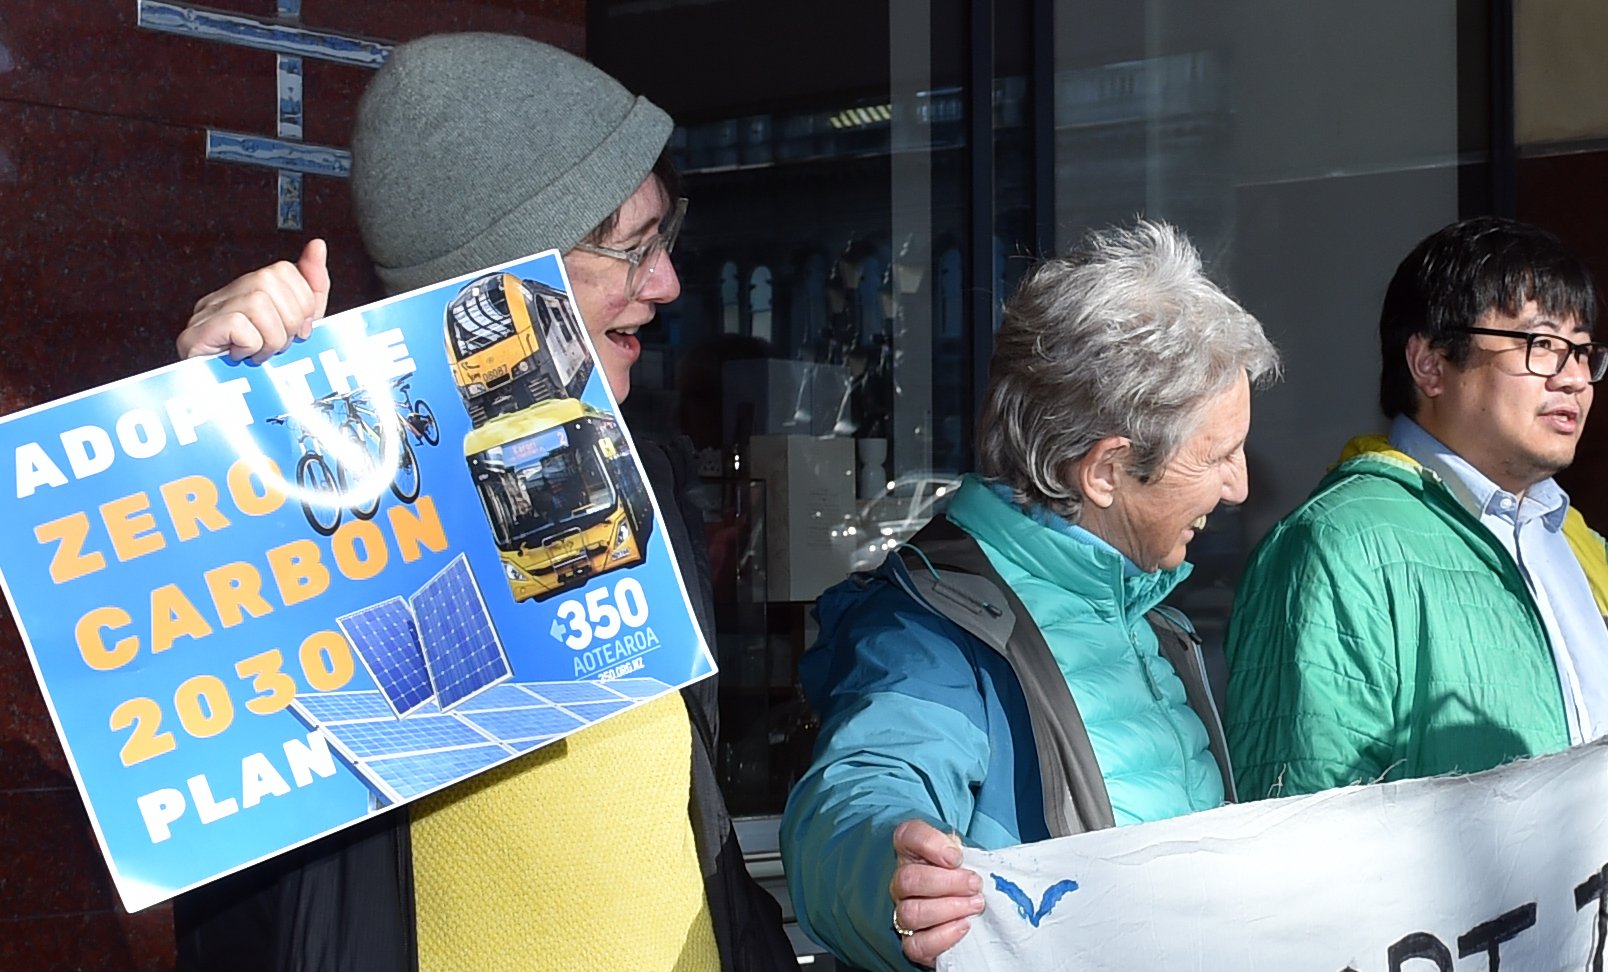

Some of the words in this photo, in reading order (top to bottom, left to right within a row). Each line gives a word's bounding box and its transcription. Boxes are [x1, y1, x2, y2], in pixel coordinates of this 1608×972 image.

[13, 376, 255, 498] ADOPT
[270, 327, 417, 408] THE
[36, 457, 288, 585] ZERO
[74, 494, 449, 671] CARBON
[557, 577, 649, 650] 350
[573, 627, 660, 677] AOTEAROA
[109, 630, 357, 768] 2030
[136, 729, 339, 844] PLAN
